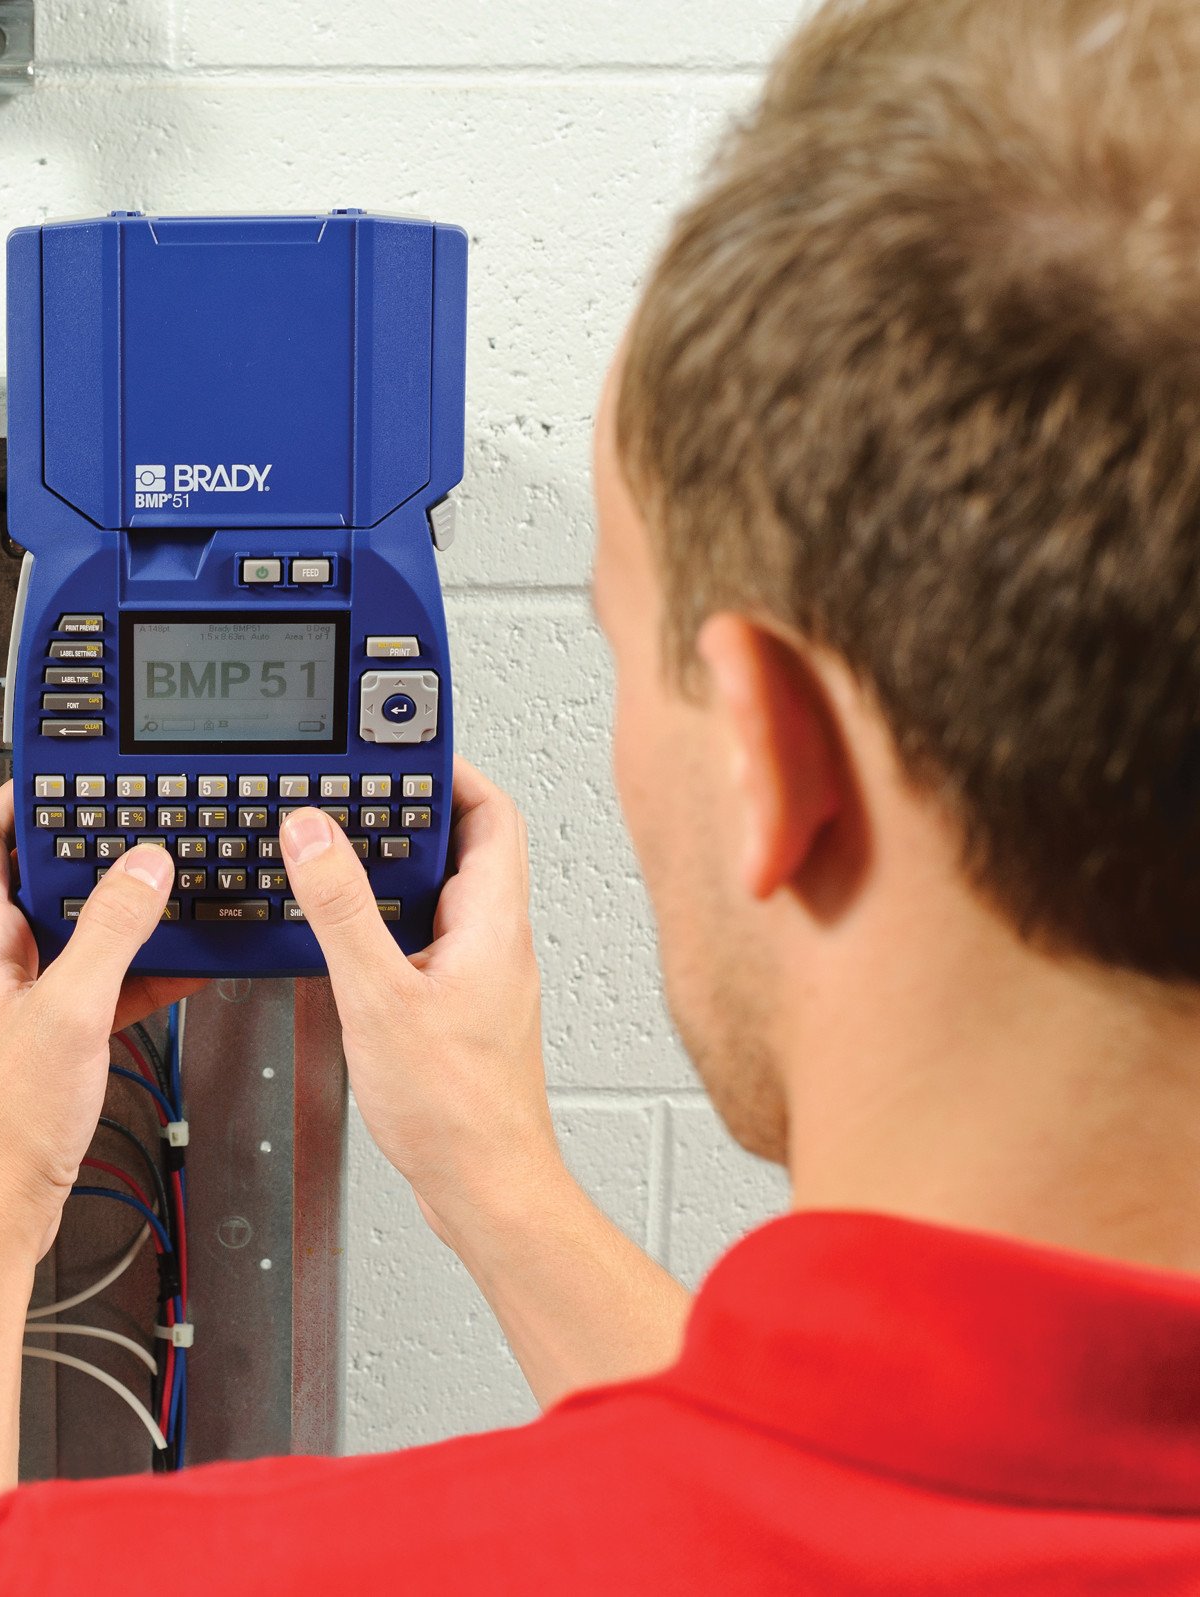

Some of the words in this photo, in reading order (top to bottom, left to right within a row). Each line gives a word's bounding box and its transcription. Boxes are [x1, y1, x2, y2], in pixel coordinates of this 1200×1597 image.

[174, 464, 273, 492] BRADY
[302, 568, 320, 577] FEED
[208, 625, 230, 633] Brady
[389, 648, 411, 656] PRINT
[40, 781, 48, 796] 1
[80, 781, 89, 796] 2
[122, 781, 131, 796] 3
[161, 781, 170, 796] 4
[203, 781, 212, 796] 5
[242, 781, 251, 796] 6
[284, 781, 293, 796] 7
[324, 781, 333, 796] 8
[366, 781, 375, 796] 9
[406, 781, 415, 796] 0
[39, 812, 49, 826] Q
[81, 812, 95, 826] W
[121, 812, 130, 826] E
[160, 812, 171, 826] R
[202, 812, 212, 826] T
[243, 812, 254, 826] Y
[365, 812, 375, 826] O
[405, 812, 415, 826] P
[60, 843, 71, 857] A
[100, 843, 109, 857] S
[181, 843, 190, 857] F
[222, 843, 232, 857] G
[262, 843, 273, 857] H
[384, 843, 393, 857] L
[181, 874, 191, 888] C
[221, 874, 232, 888] V
[261, 874, 271, 888] B
[219, 909, 242, 917] SPACE
